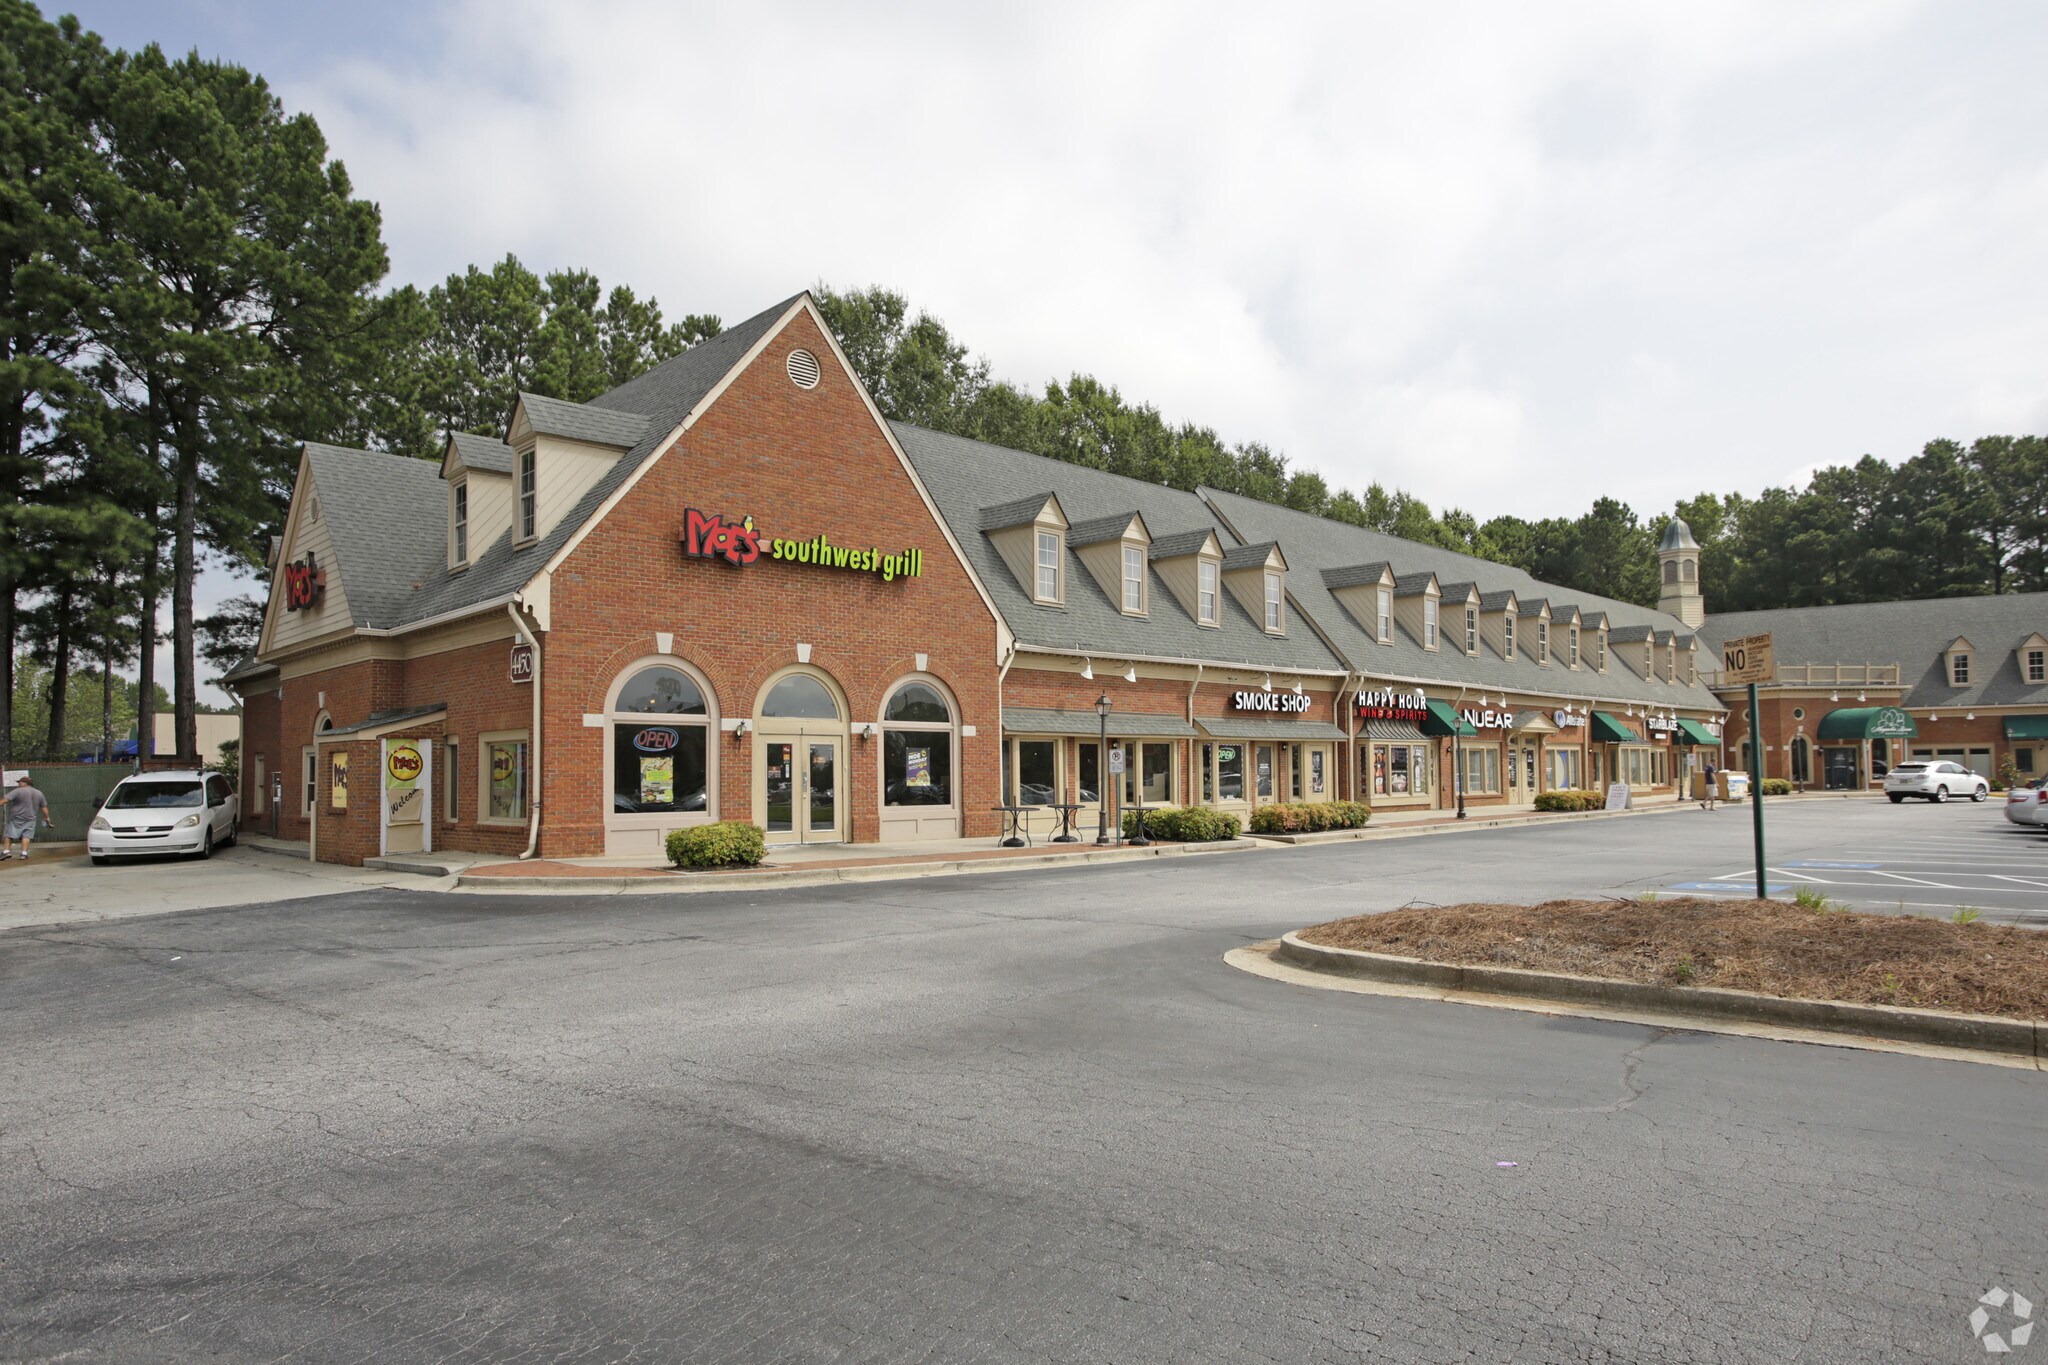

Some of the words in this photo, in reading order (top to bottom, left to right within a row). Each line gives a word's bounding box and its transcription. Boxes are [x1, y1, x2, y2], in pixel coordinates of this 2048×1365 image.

[772, 534, 881, 572] southwest
[883, 548, 922, 581] grill
[1723, 639, 1744, 649] PRIVATE
[1745, 634, 1770, 646] PROPERTY
[512, 653, 532, 675] 4450
[1725, 649, 1745, 672] NO
[1235, 691, 1279, 711] SMOKE
[1281, 694, 1311, 712] SHOP
[1359, 690, 1394, 708] HAPPY
[1399, 694, 1427, 710] HOUR
[1360, 707, 1384, 719] WINE
[1386, 709, 1393, 719] &
[1395, 709, 1428, 721] SPIRITS
[637, 730, 674, 749] OPEN
[1218, 750, 1234, 760] OPEN
